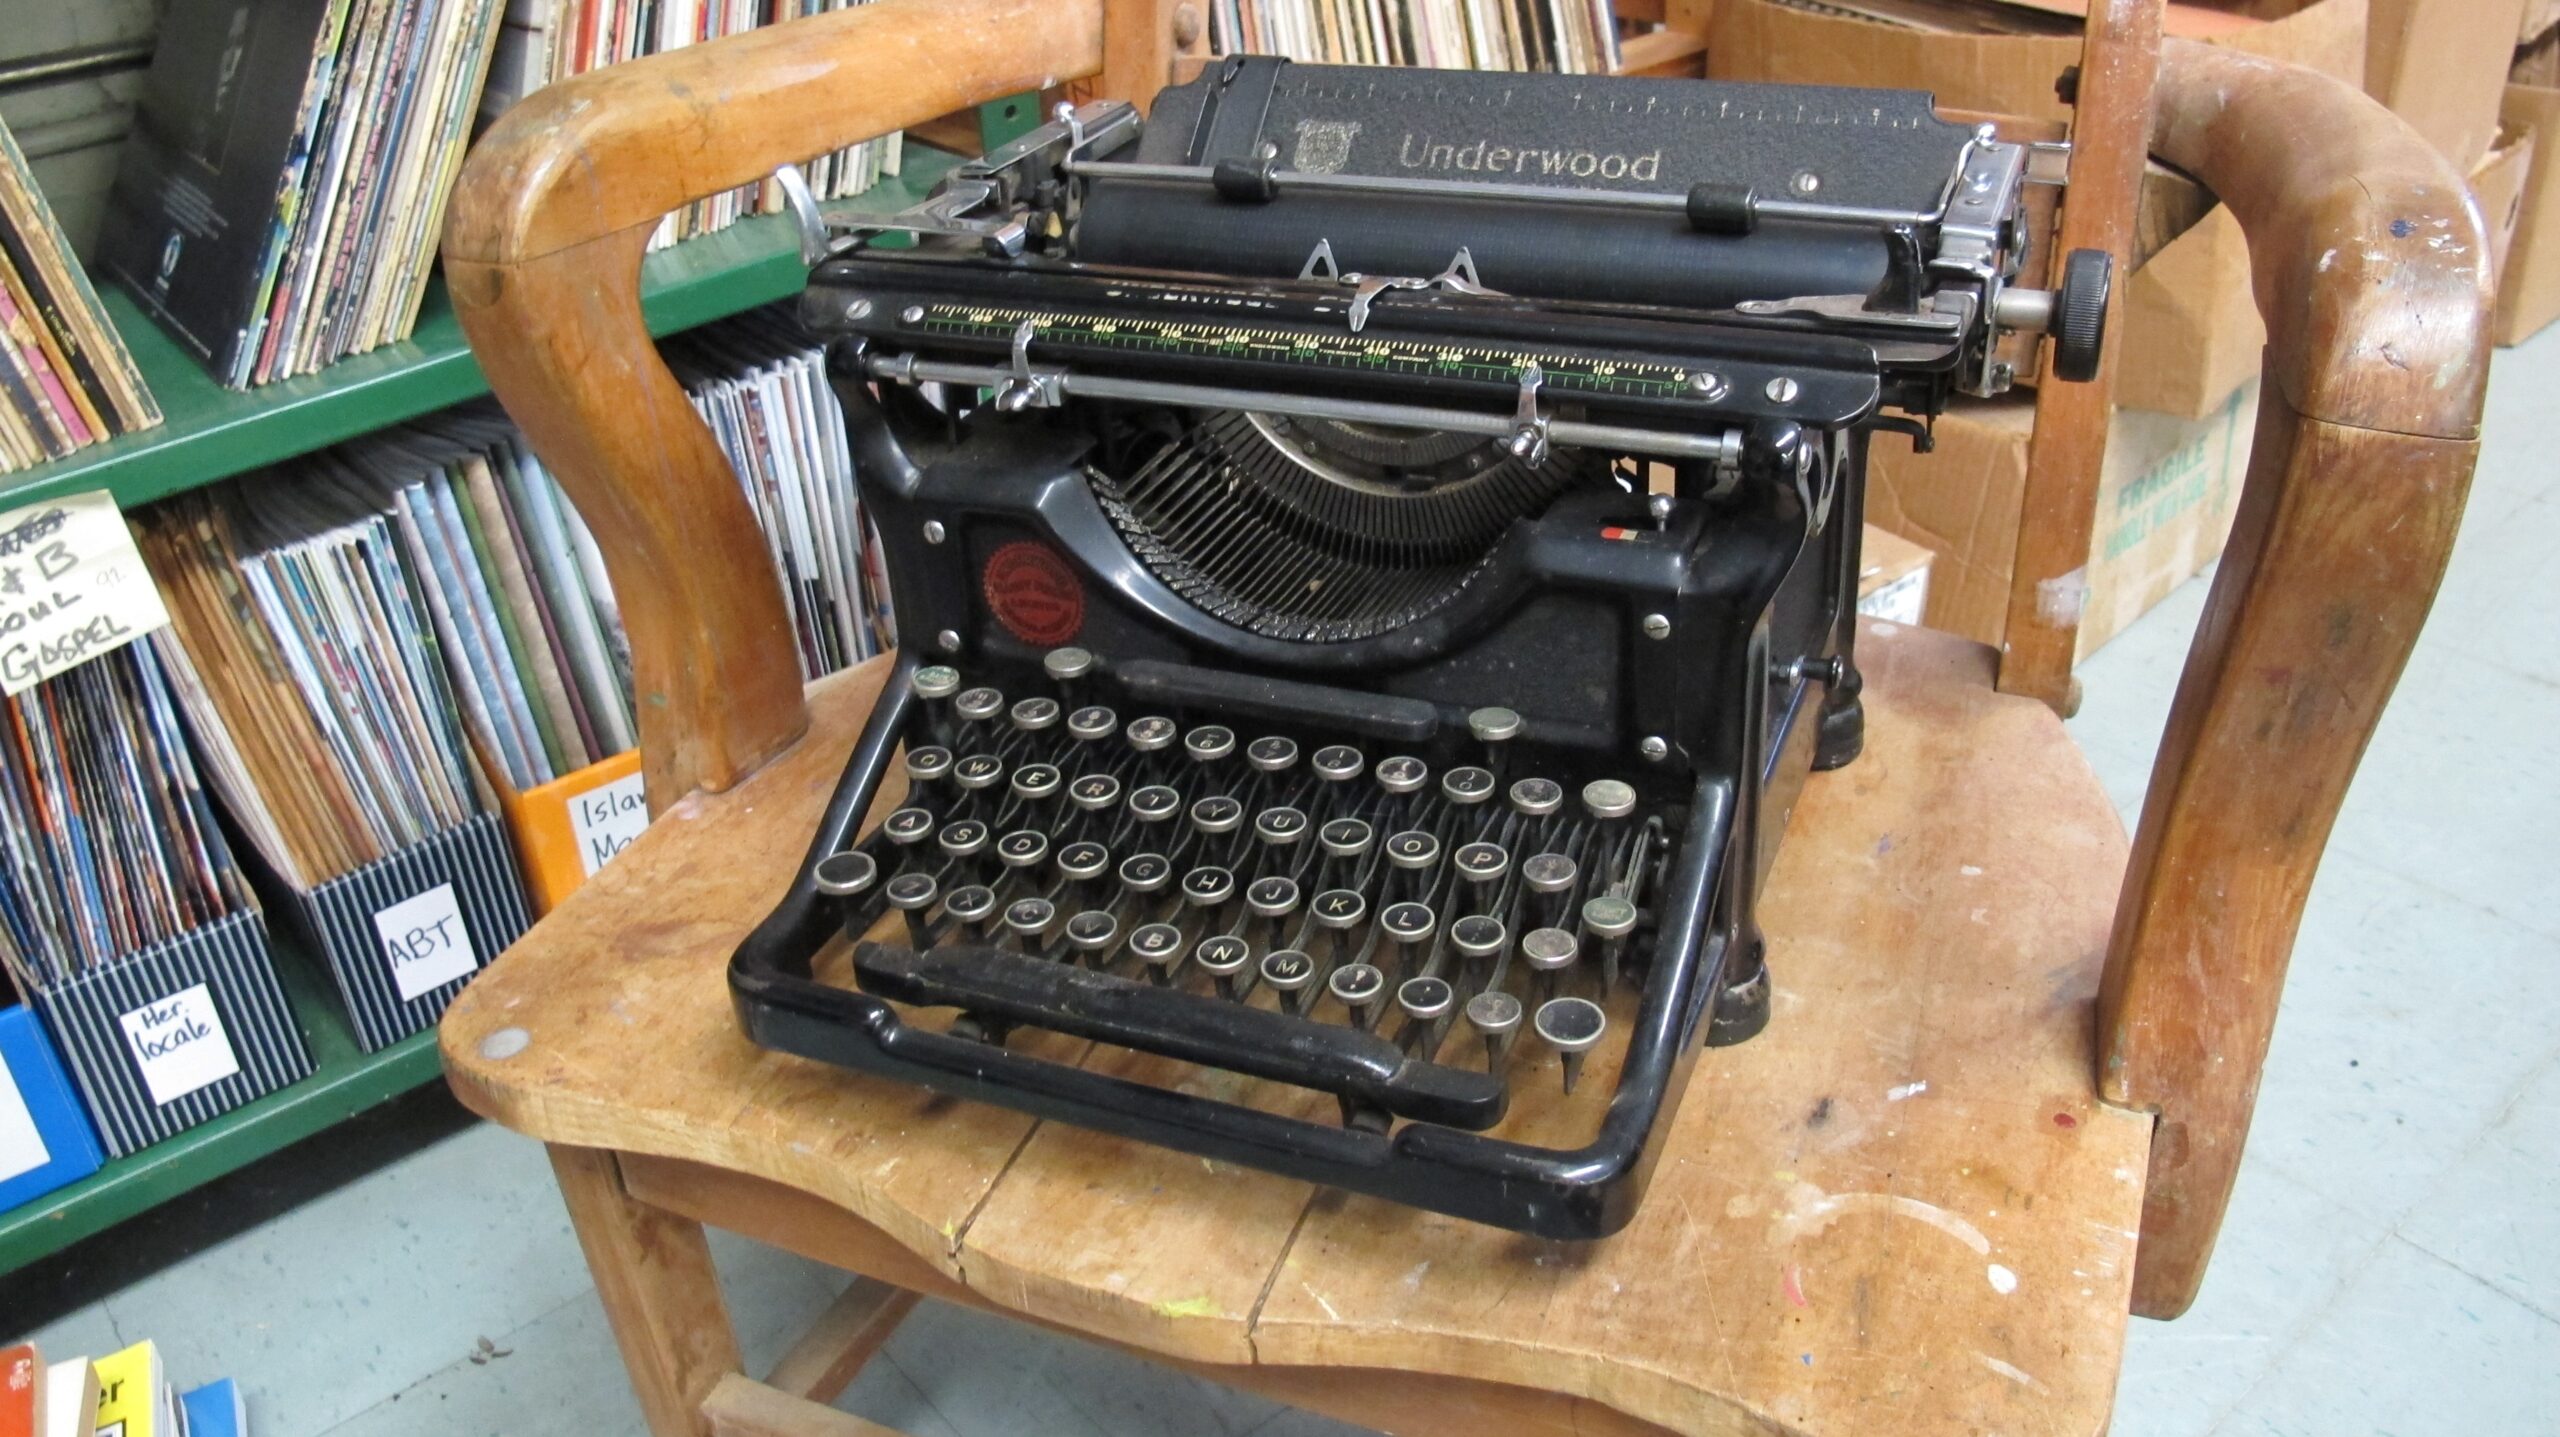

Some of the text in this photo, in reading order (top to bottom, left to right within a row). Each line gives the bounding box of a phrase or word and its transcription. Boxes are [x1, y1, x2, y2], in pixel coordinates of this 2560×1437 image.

[1400, 133, 1661, 182] Underwood
[2117, 432, 2209, 516] FRAGILE
[35, 540, 79, 582] B
[1027, 771, 1046, 784] E
[1086, 782, 1104, 795] R
[1273, 815, 1291, 828] U
[1472, 852, 1492, 864] P
[899, 816, 916, 829] A
[954, 828, 972, 841] S
[1013, 838, 1032, 851] D
[1073, 850, 1094, 863] F
[1197, 874, 1218, 889] H
[1266, 886, 1282, 900] J
[1329, 898, 1348, 913] K
[1398, 911, 1412, 927] L
[389, 914, 453, 969] ABT
[1144, 933, 1165, 948] B
[1212, 945, 1233, 960] N
[1276, 959, 1299, 975] M
[134, 1017, 211, 1061] locale
